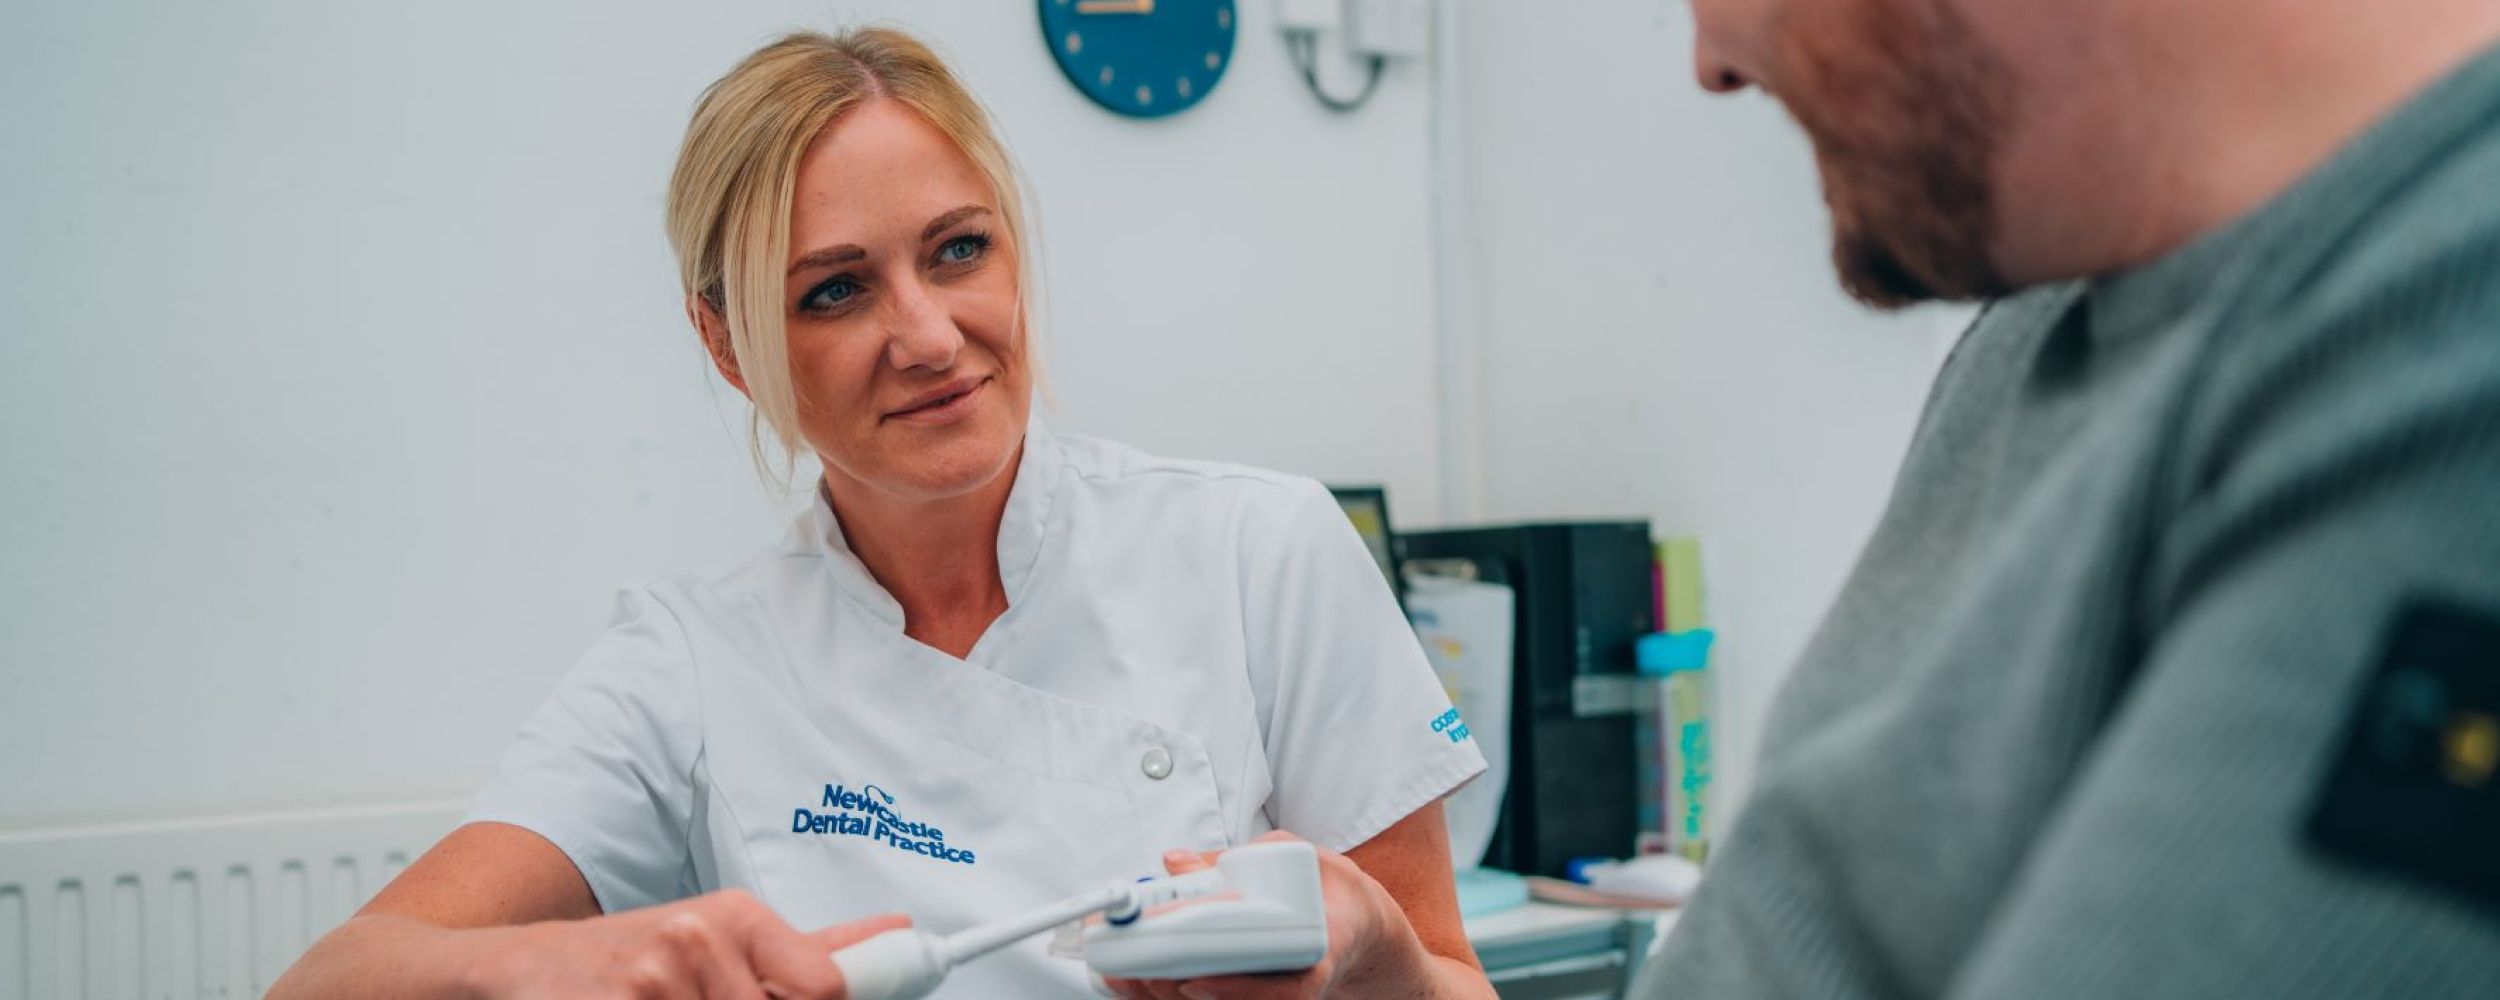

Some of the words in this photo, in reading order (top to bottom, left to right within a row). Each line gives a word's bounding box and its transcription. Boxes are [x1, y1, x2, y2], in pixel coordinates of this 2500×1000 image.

[792, 808, 871, 836] Dental
[874, 820, 976, 864] Practice
[822, 783, 943, 841] Newcastle
